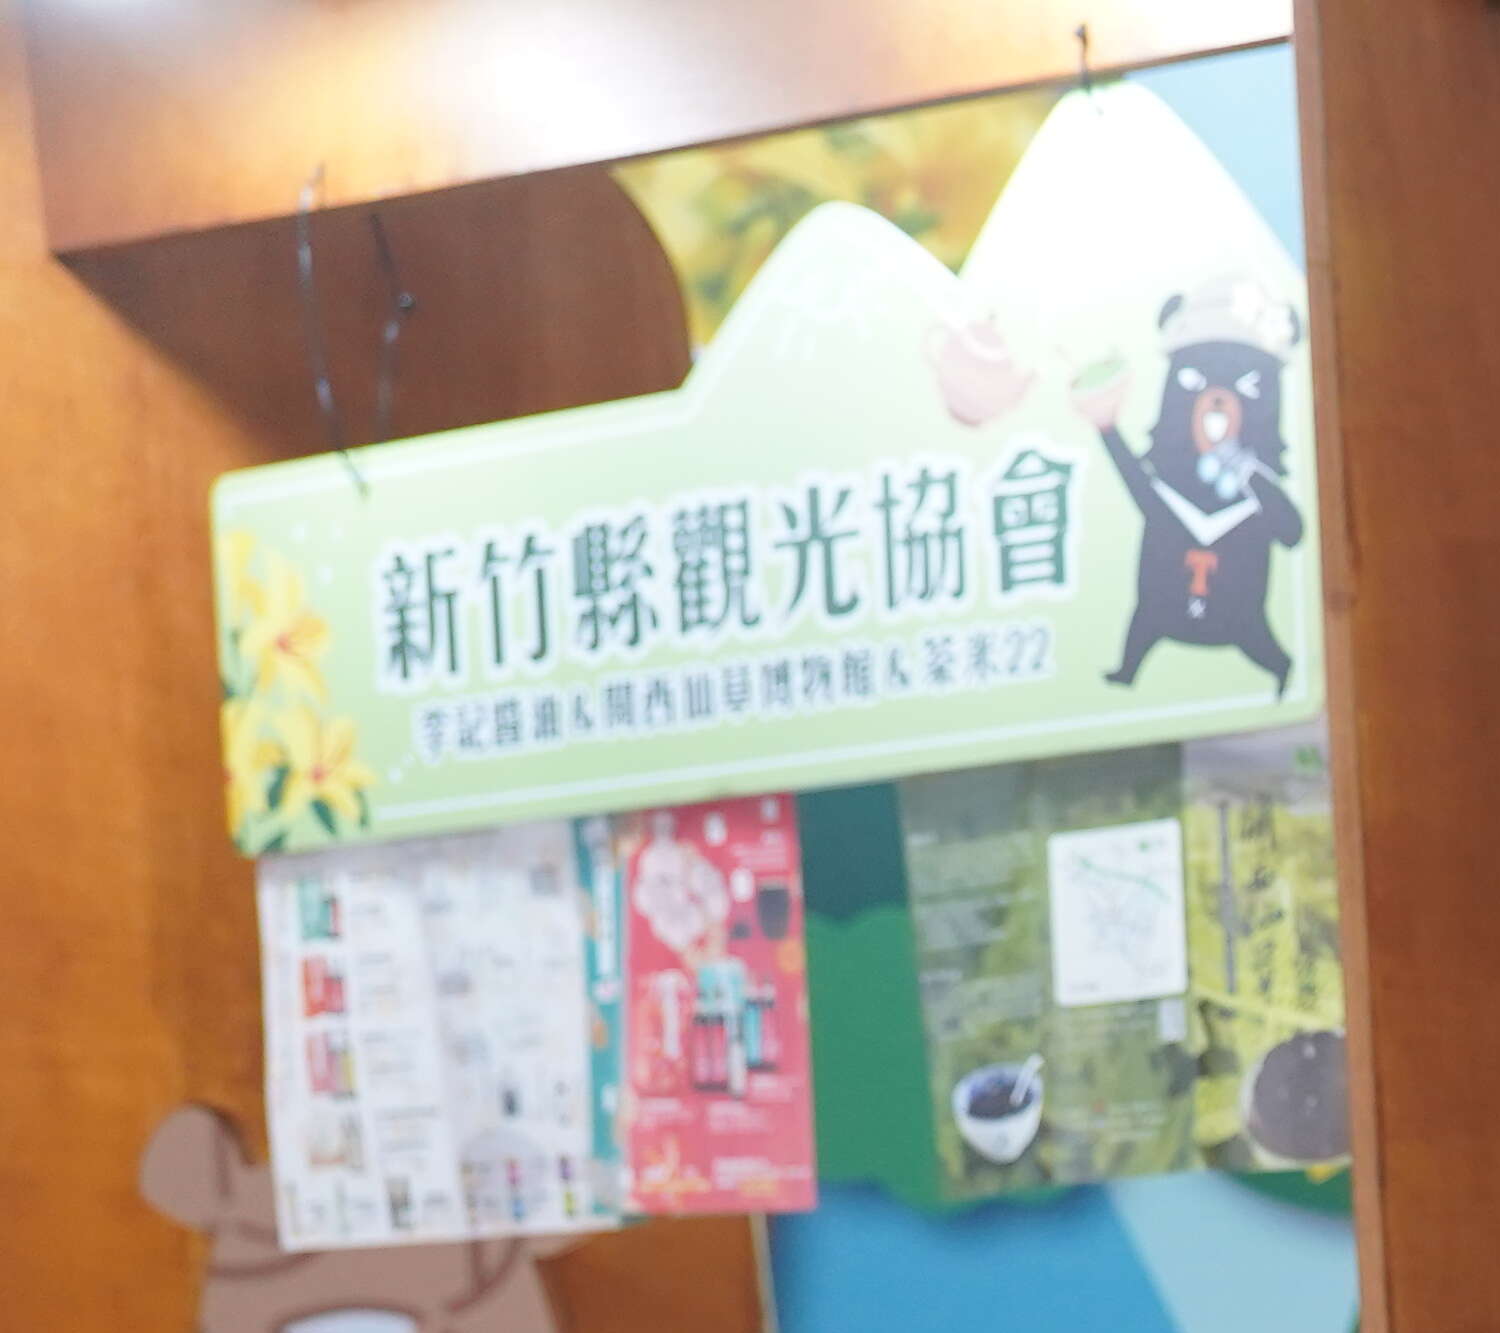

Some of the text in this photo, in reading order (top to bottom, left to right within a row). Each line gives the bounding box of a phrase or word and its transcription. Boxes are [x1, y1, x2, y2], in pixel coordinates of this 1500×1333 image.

[380, 448, 1076, 680] 新竹縣觀光協會
